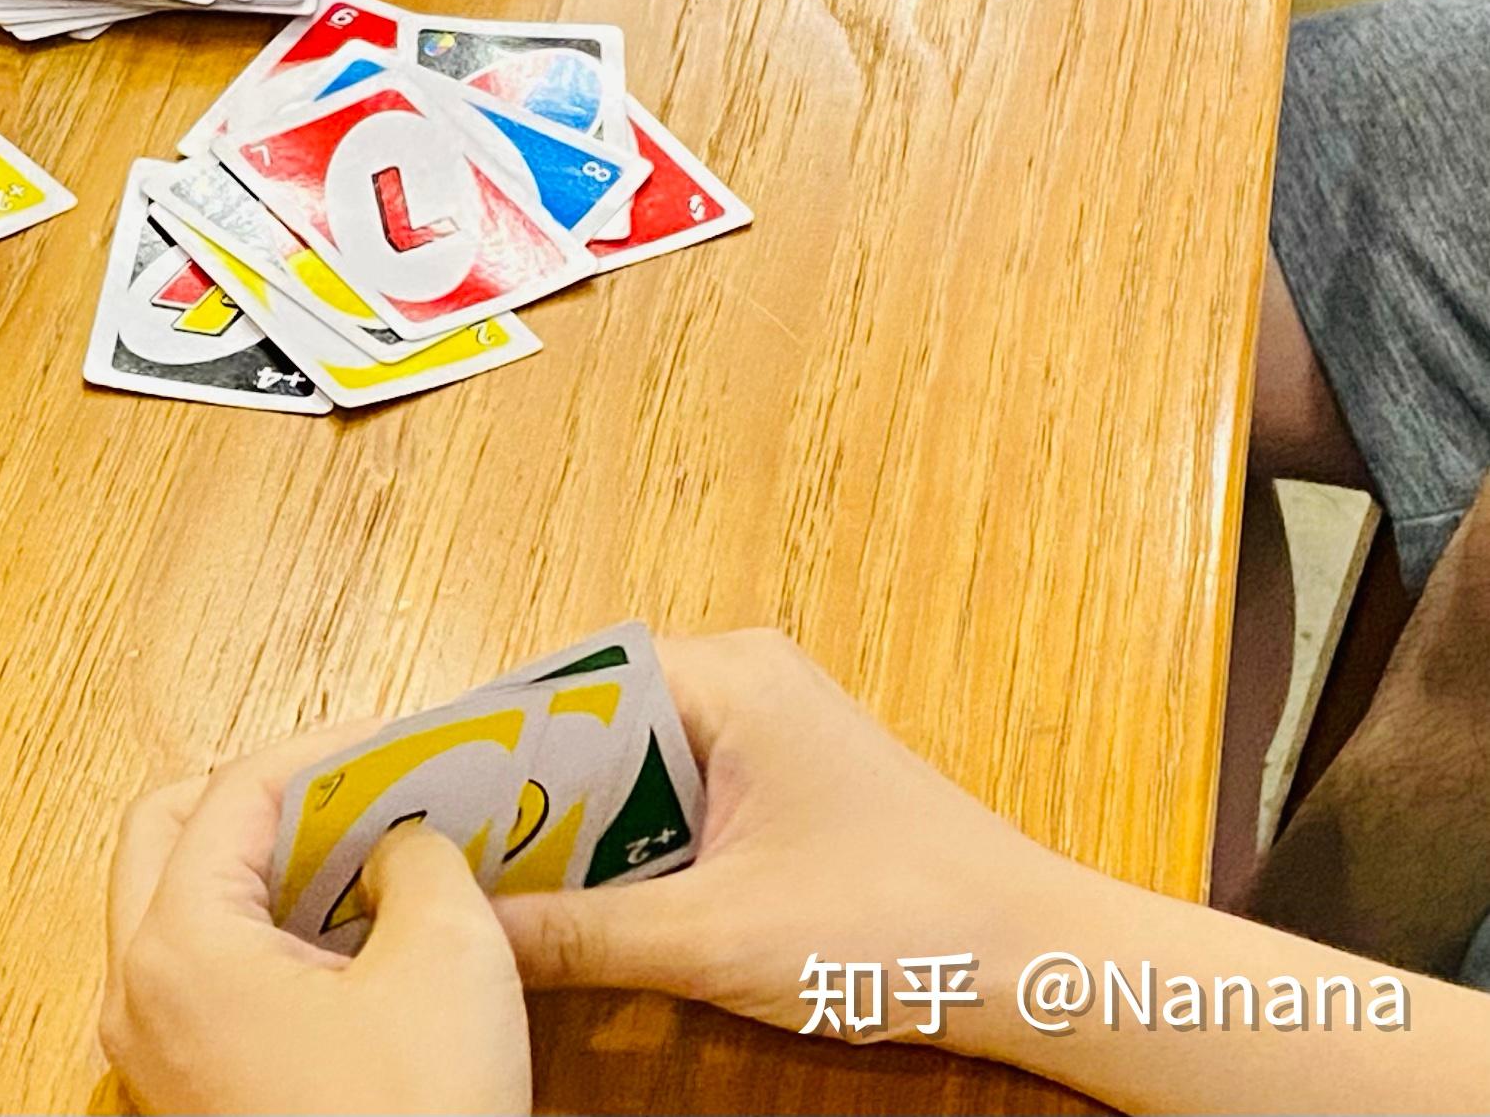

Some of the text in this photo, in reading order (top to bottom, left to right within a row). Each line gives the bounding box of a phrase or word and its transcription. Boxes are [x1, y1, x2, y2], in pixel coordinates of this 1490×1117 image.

[583, 161, 611, 183] 8
[255, 366, 307, 389] +4
[626, 827, 677, 864] +2
